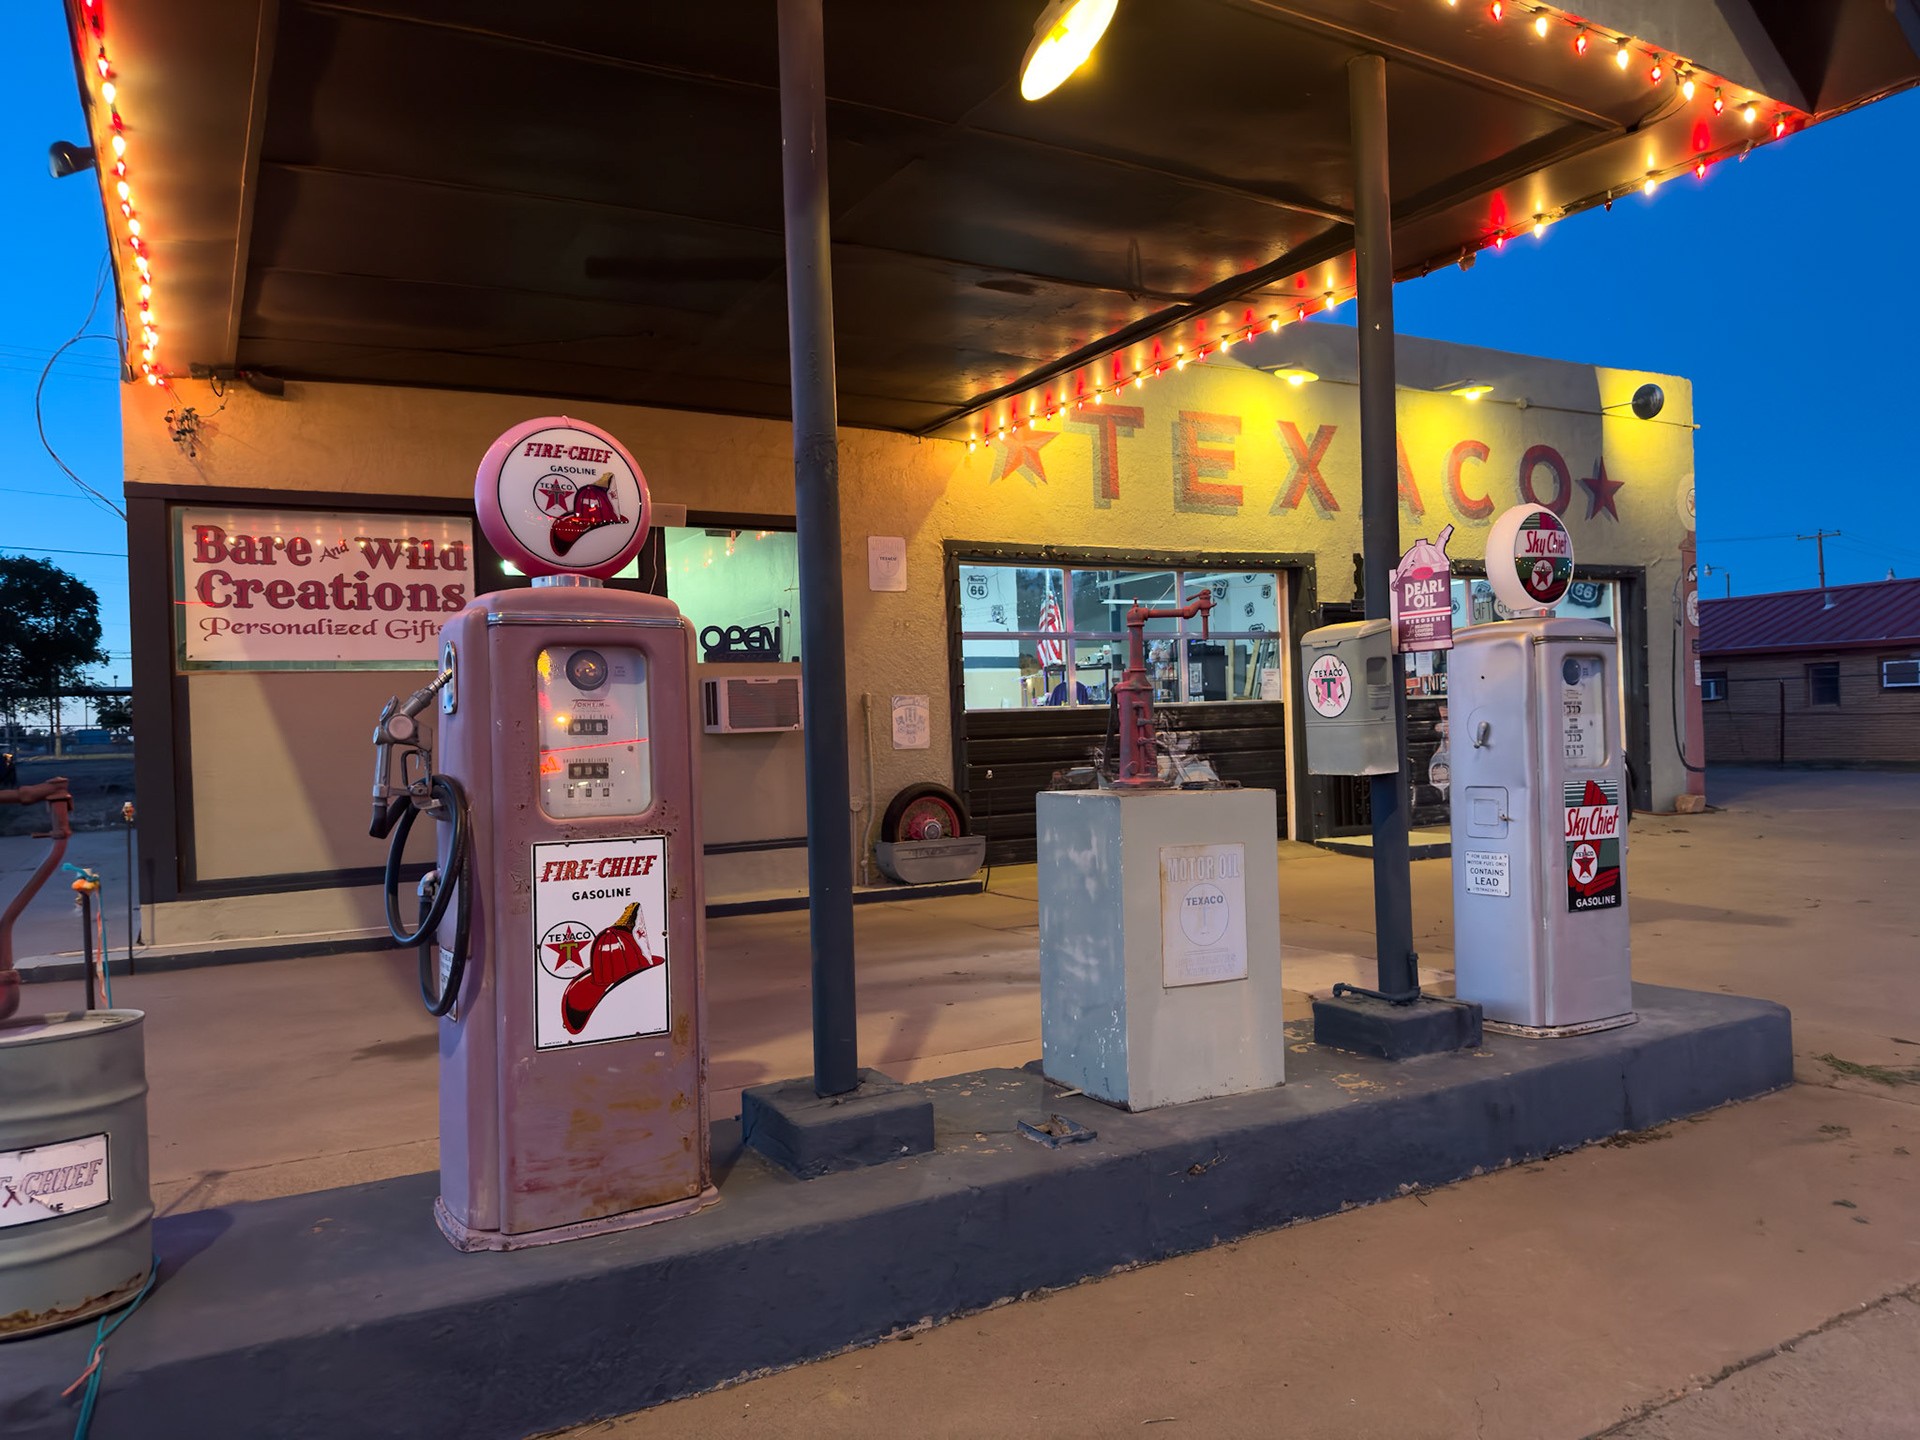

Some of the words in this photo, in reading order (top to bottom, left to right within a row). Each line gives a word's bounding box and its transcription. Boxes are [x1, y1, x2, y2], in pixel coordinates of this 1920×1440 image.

[524, 442, 613, 464] FIRE-CHIEF
[550, 465, 597, 475] GASOLINE
[540, 482, 573, 490] TEXACO
[192, 525, 312, 566] Bare
[319, 538, 350, 562] And
[354, 536, 468, 571] Wild
[1525, 530, 1546, 556] Sky
[1547, 531, 1567, 555] Chief
[195, 569, 468, 612] Creations
[970, 585, 985, 595] 66
[1405, 579, 1446, 606] PEARL
[1575, 583, 1594, 599] 66
[1413, 594, 1437, 608] OIL
[1405, 616, 1446, 624] KEROSENE
[199, 617, 379, 641] Personalized
[700, 625, 780, 652] OPEN
[1314, 669, 1344, 677] TEXACO
[1565, 807, 1590, 840] Sky
[1589, 806, 1620, 835] Chief
[1575, 850, 1594, 858] TEXACO
[539, 855, 658, 883] FIRE-CHIEF
[1167, 855, 1215, 882] MOTOR
[1218, 853, 1240, 879] OIL
[1470, 867, 1505, 876] CONTAINS
[1475, 876, 1499, 886] LEAD
[572, 888, 631, 900] GASOLINE
[1186, 895, 1224, 907] TEXACO
[1576, 895, 1616, 907] GASOLINE
[548, 931, 591, 943] TEXACO
